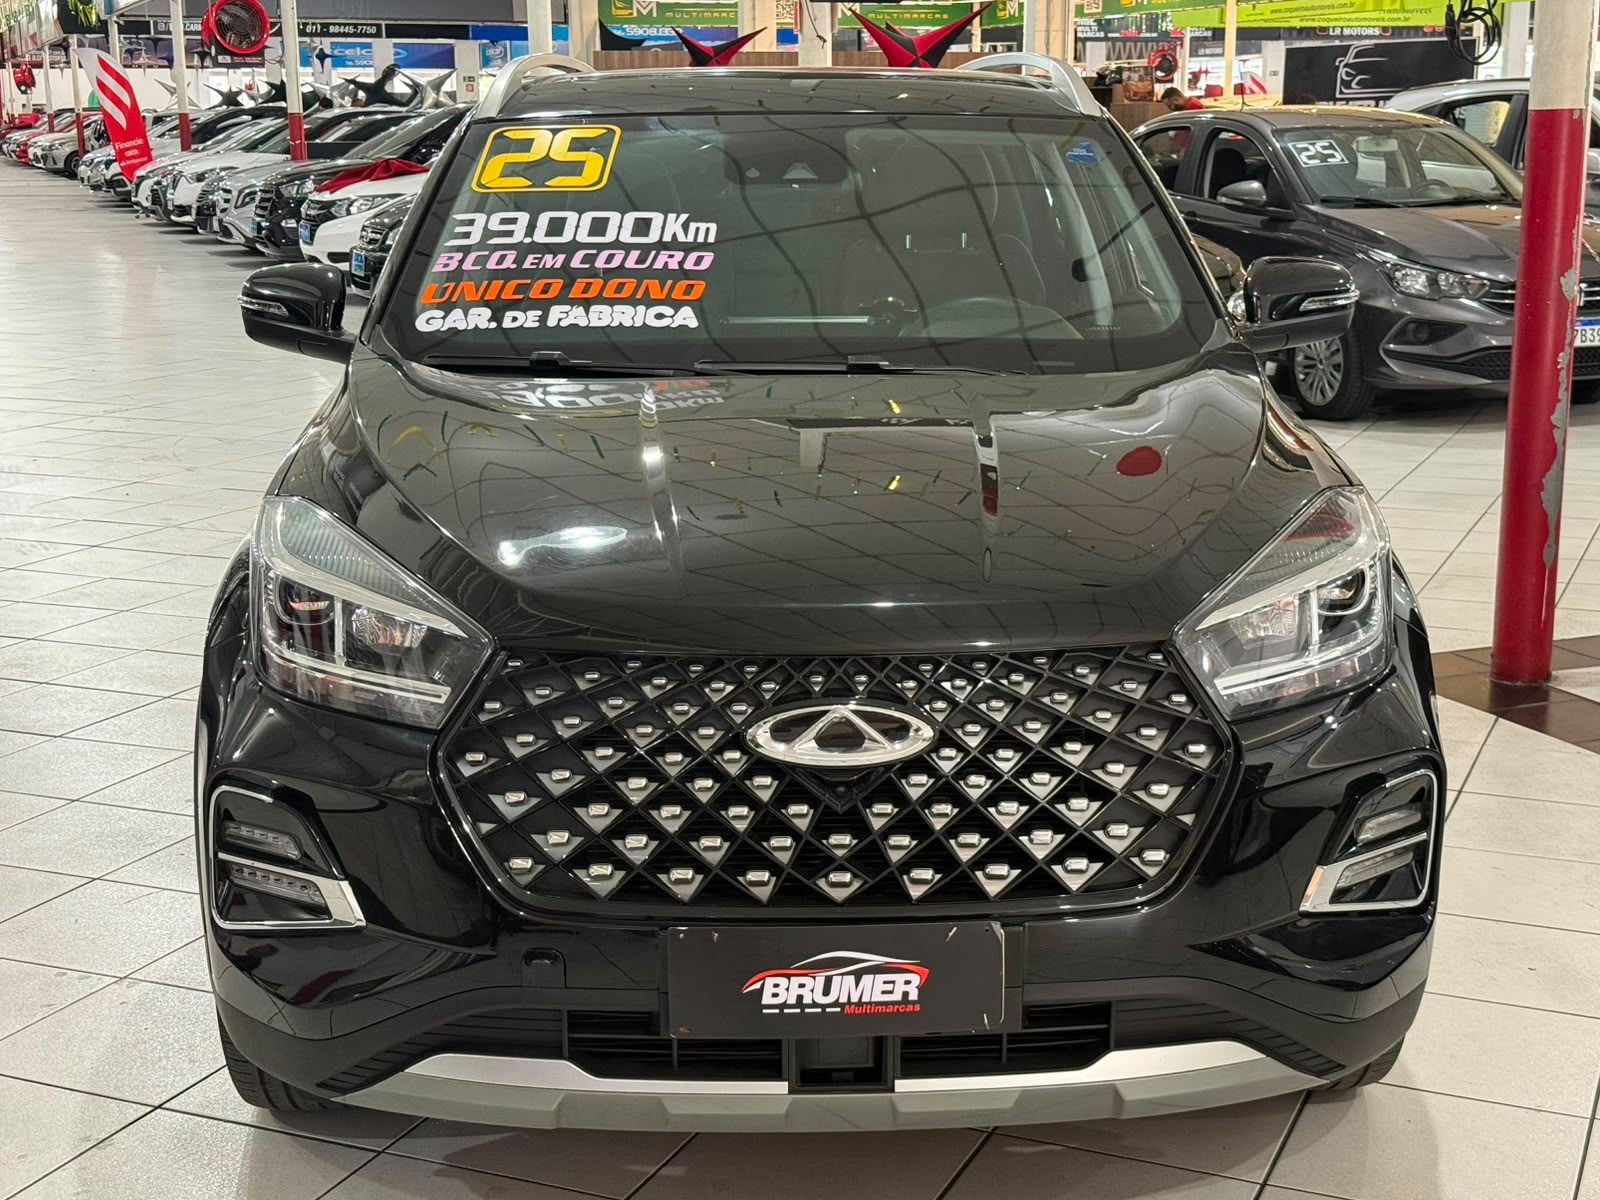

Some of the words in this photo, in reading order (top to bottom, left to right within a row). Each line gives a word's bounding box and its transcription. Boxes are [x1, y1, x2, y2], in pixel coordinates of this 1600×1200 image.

[306, 25, 320, 33] 011
[328, 25, 377, 34] 98445-7750
[1329, 27, 1341, 36] LR
[1343, 27, 1380, 36] MOTORS
[115, 138, 144, 150] Financie
[1295, 142, 1342, 164] 25
[480, 128, 609, 189] 25
[443, 211, 718, 246] 39.000Km
[522, 253, 567, 269] EM
[569, 249, 715, 270] COURO
[568, 278, 706, 300] DONO
[415, 307, 498, 332] GAR.
[502, 310, 543, 329] DE
[761, 972, 920, 1005] BRUMER
[844, 1002, 921, 1015] Multimarcas
